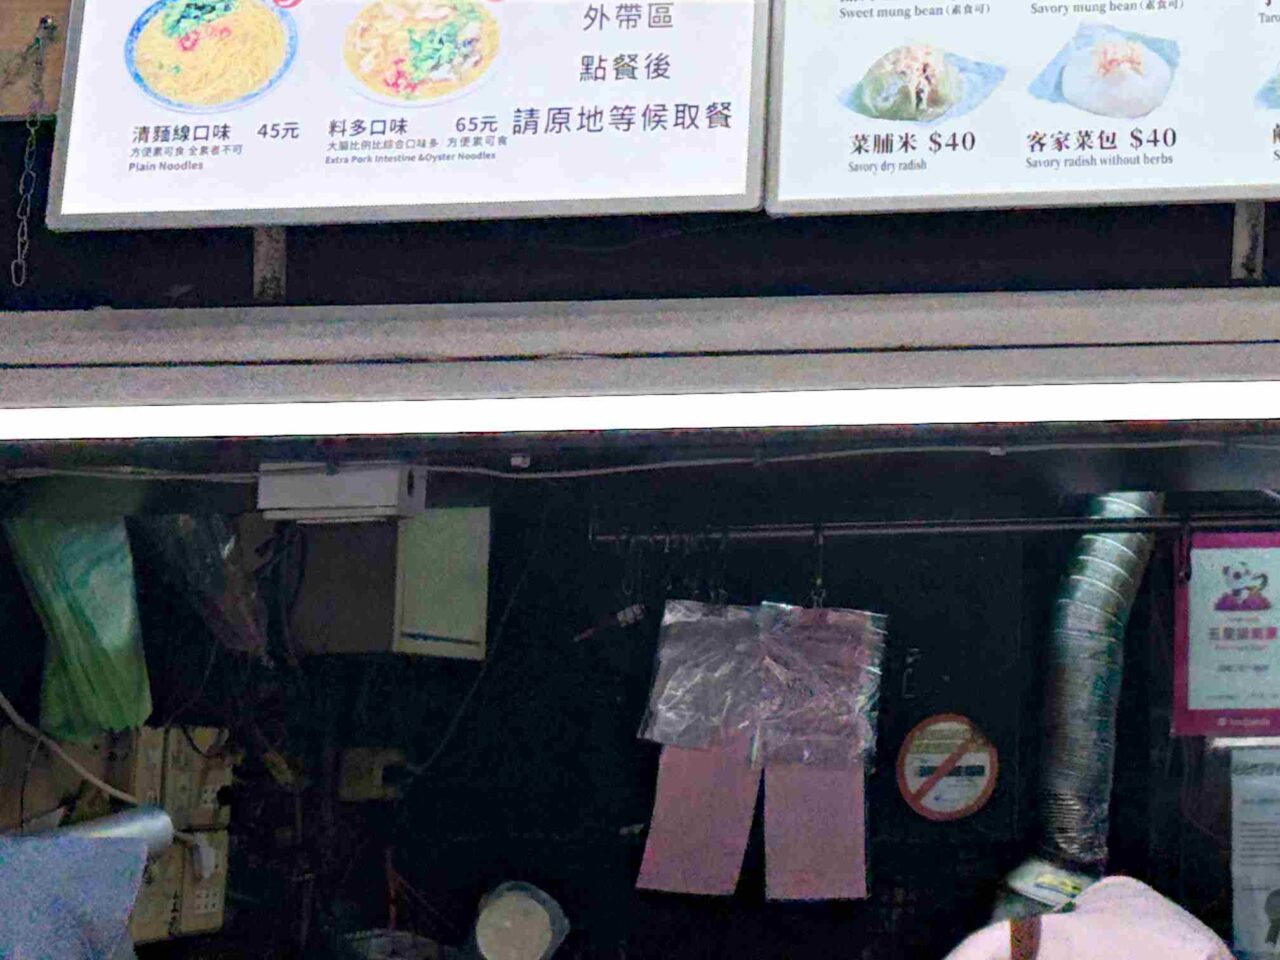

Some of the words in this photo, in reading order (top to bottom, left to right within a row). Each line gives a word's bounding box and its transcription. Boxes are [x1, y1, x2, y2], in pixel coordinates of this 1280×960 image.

[583, 2, 674, 31] 外帶區
[840, 7, 873, 19] Sweet
[877, 7, 911, 19] mung
[914, 5, 943, 16] bean
[1031, 3, 1069, 16] Savory
[1074, 2, 1106, 14] mung
[1109, 0, 1137, 11] bean
[1258, 12, 1280, 23] Taro
[580, 53, 671, 82] 點餐後
[328, 118, 408, 137] 料多口味
[456, 115, 498, 132] 65元
[512, 101, 732, 135] 請原地等候取餐
[257, 121, 300, 139] 45元
[850, 132, 917, 155] 菜脯米
[929, 131, 976, 154] $40
[1027, 129, 1117, 153] 客家菜包
[1130, 127, 1177, 150] $40
[128, 162, 156, 172] Plain
[159, 160, 204, 171] Noodles
[325, 155, 349, 165] Extra
[351, 155, 373, 164] Pork
[375, 153, 416, 163] Intestine
[458, 150, 496, 161] Noodles
[1026, 157, 1060, 170] Savory
[1064, 155, 1097, 167] radish
[1100, 154, 1141, 165] without
[1143, 153, 1173, 165] herbs
[848, 161, 878, 175] Savory
[880, 160, 896, 173] dry
[898, 158, 927, 170] radish
